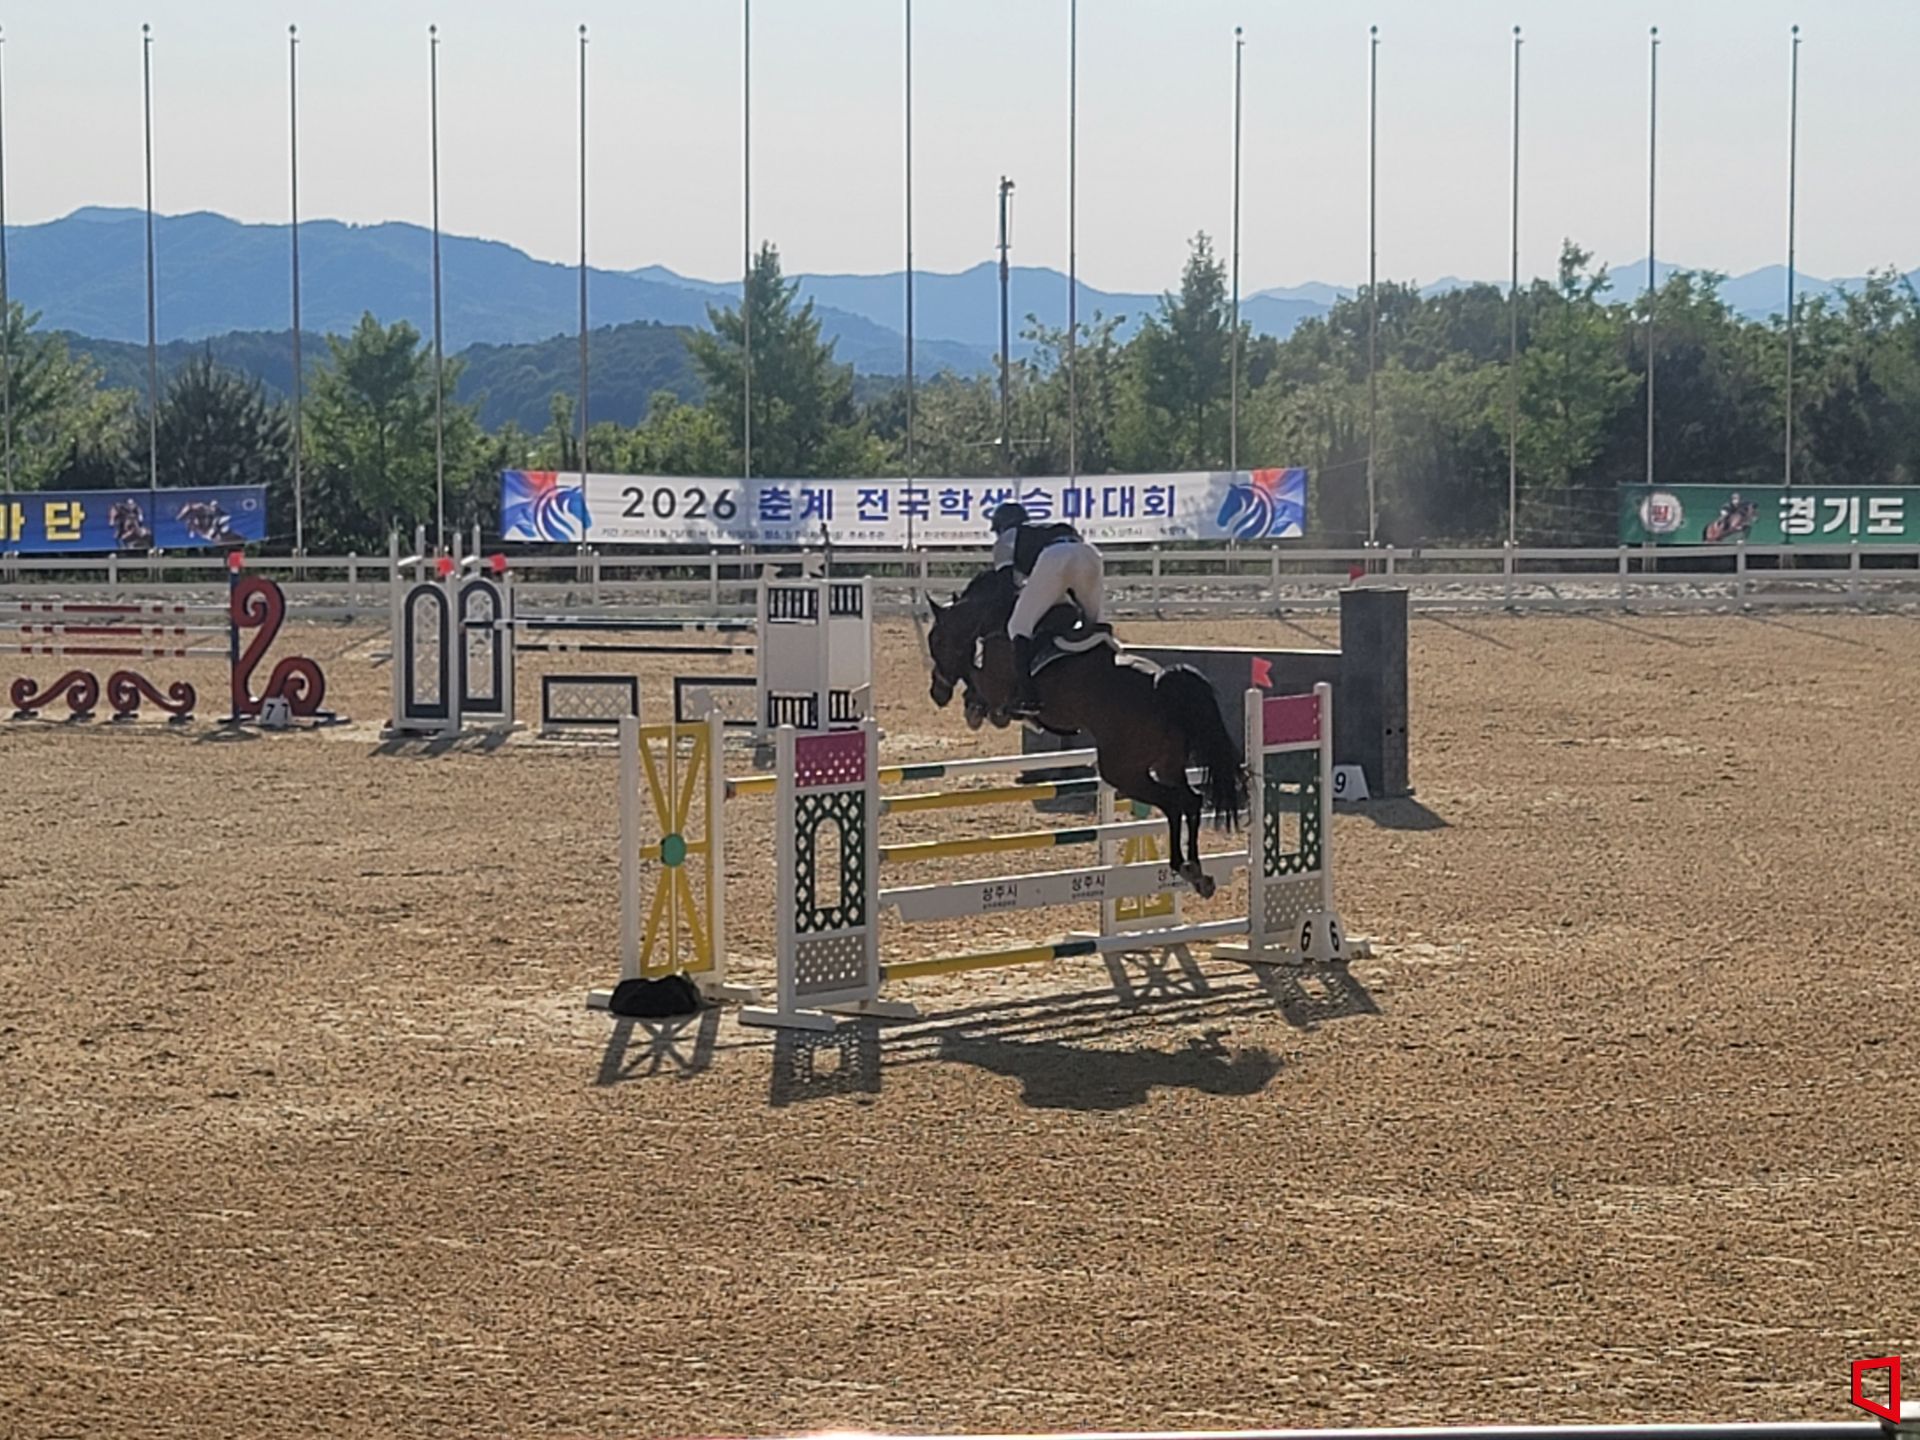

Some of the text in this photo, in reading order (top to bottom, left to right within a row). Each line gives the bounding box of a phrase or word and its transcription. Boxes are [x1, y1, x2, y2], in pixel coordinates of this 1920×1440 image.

[621, 484, 1177, 522] 2026 춘계 전국학생승마대회
[1779, 495, 1905, 535] 경기도
[266, 703, 276, 720] 7
[1334, 771, 1347, 793] 9
[983, 883, 1018, 902] 상주시
[1072, 872, 1105, 892] 상주시
[1301, 920, 1312, 951] 6
[1329, 920, 1340, 951] 6
